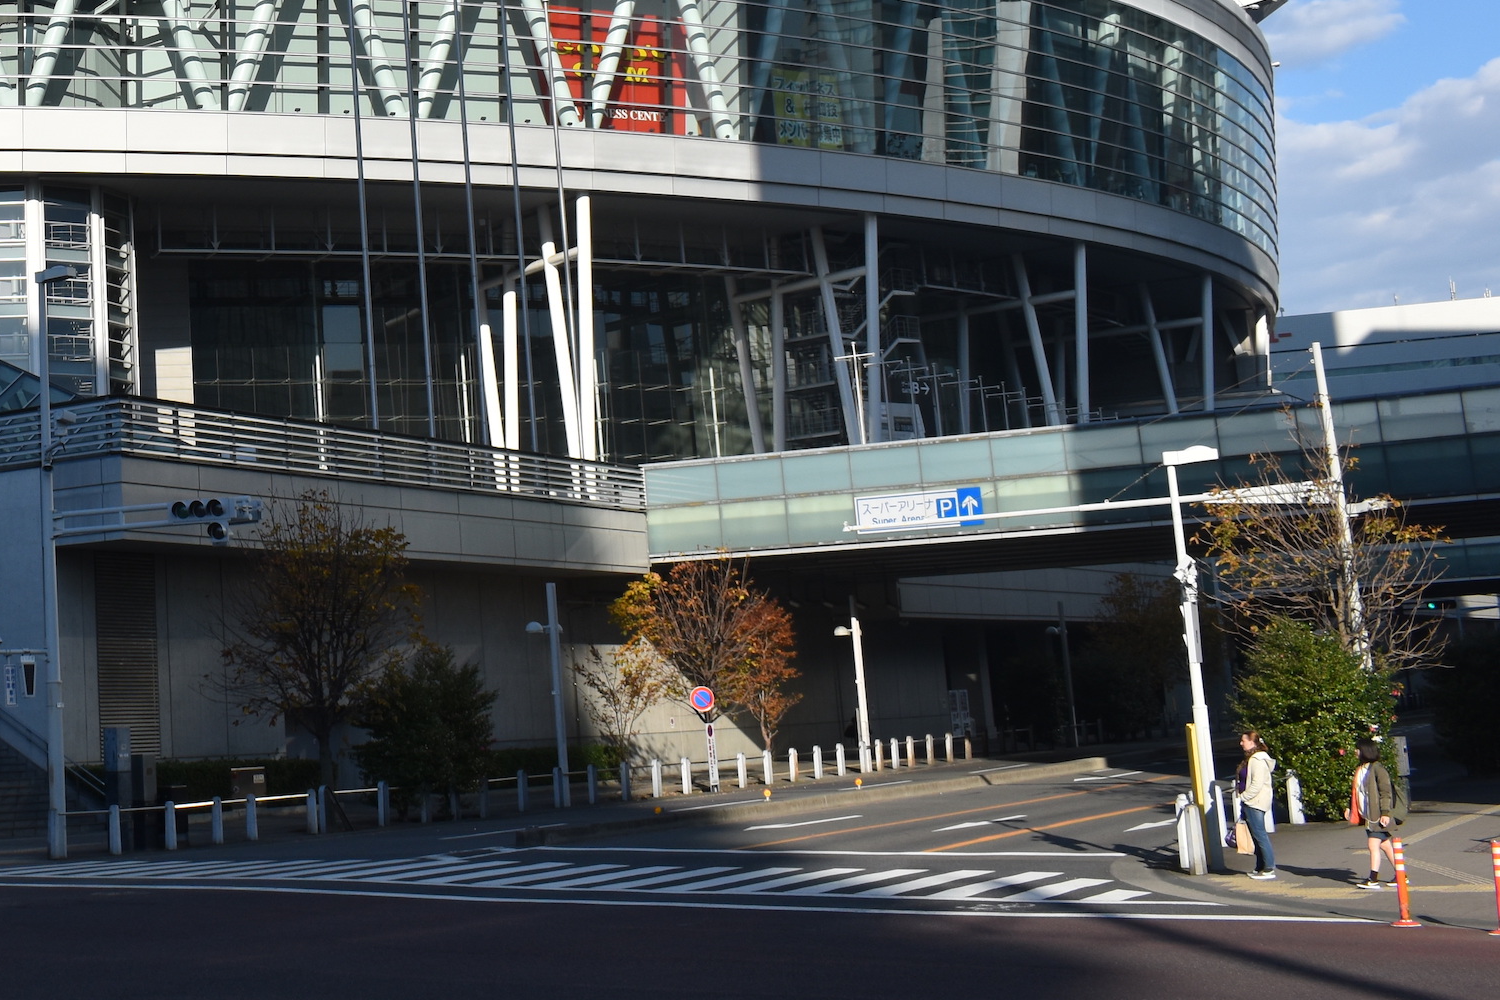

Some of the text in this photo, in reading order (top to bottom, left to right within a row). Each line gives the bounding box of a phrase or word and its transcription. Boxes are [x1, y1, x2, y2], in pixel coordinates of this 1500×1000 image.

[629, 109, 666, 122] CENTE
[863, 498, 953, 518] スーパーアリーナ P
